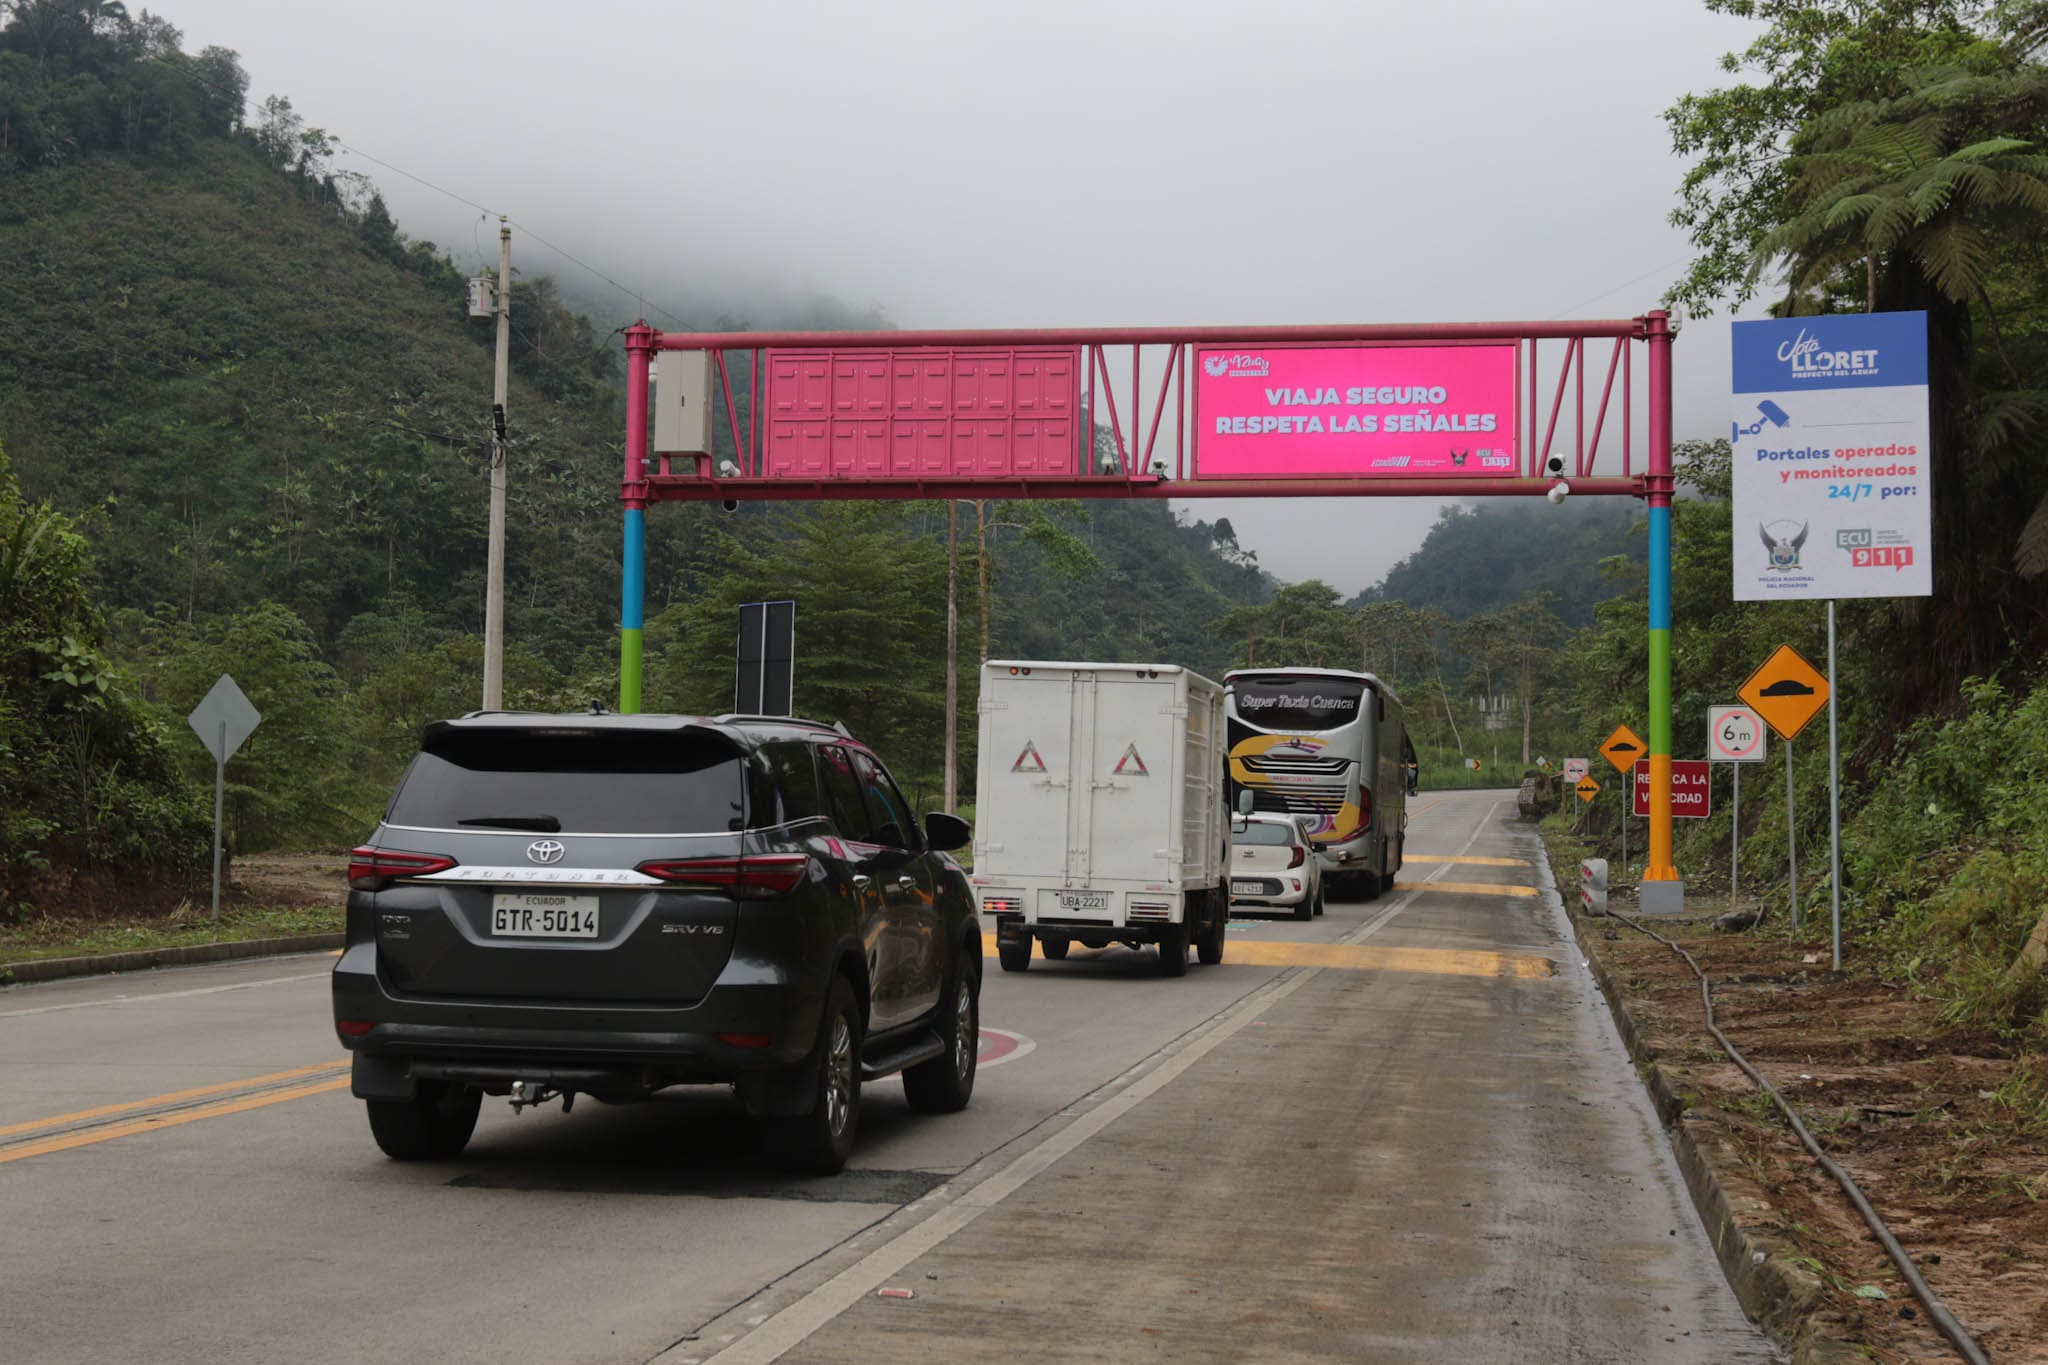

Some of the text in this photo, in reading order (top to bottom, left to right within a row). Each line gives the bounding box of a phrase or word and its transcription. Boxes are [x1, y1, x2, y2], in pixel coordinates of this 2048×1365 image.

[1792, 350, 1879, 371] LLORET
[1792, 370, 1833, 378] PREFECTO
[1265, 386, 1447, 405] VIAJA SEGURO
[1216, 409, 1497, 434] RESPETA LAS SEÑALES
[1757, 443, 1917, 461] Portales operados
[1780, 463, 1917, 484] y monitoreados
[1828, 483, 1917, 502] 24/7 por:
[1839, 533, 1869, 546] ECU
[1857, 550, 1909, 565] 911
[1240, 694, 1277, 710] Super
[1723, 725, 1751, 741] 6 m
[1637, 773, 1707, 785] RECA LA
[1641, 792, 1703, 803] VCIDAD
[526, 897, 566, 906] ECUADOR
[1062, 896, 1104, 907] UBA-2221
[495, 909, 594, 932] GTR-5014
[661, 924, 725, 934] SRV V6
